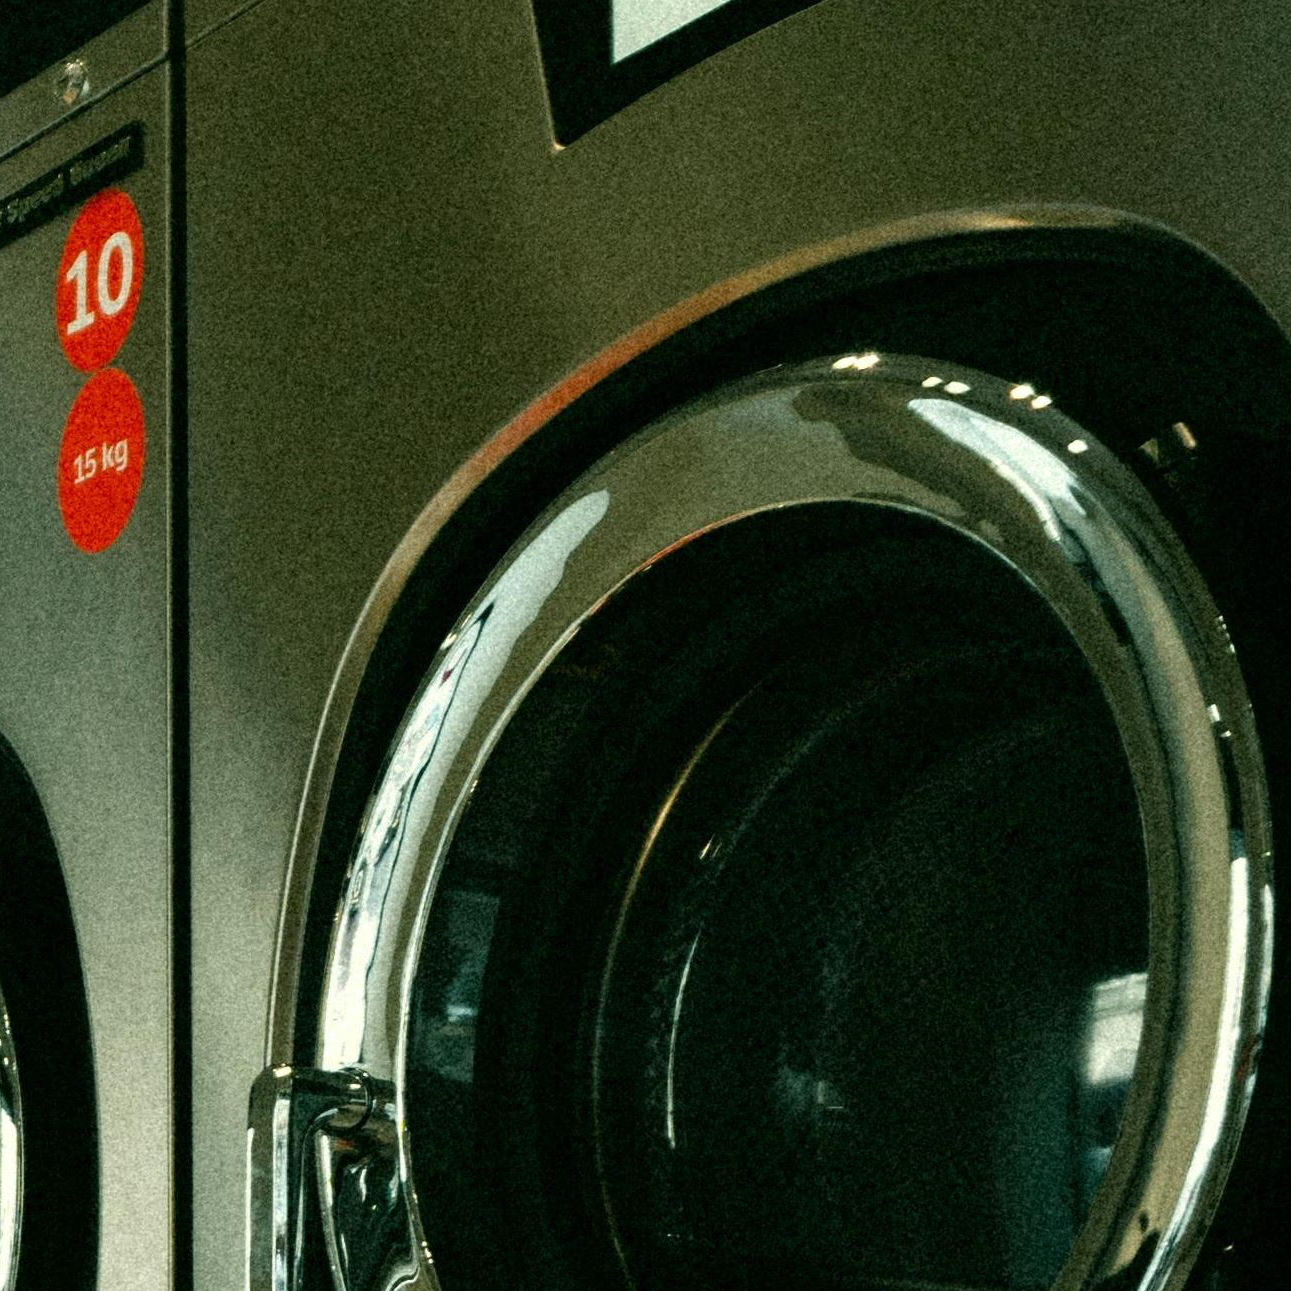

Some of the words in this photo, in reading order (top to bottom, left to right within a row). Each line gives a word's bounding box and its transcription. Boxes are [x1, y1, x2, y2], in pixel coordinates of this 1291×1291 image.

[67, 231, 133, 335] 10
[74, 448, 97, 485] 15
[102, 439, 128, 473] kg
